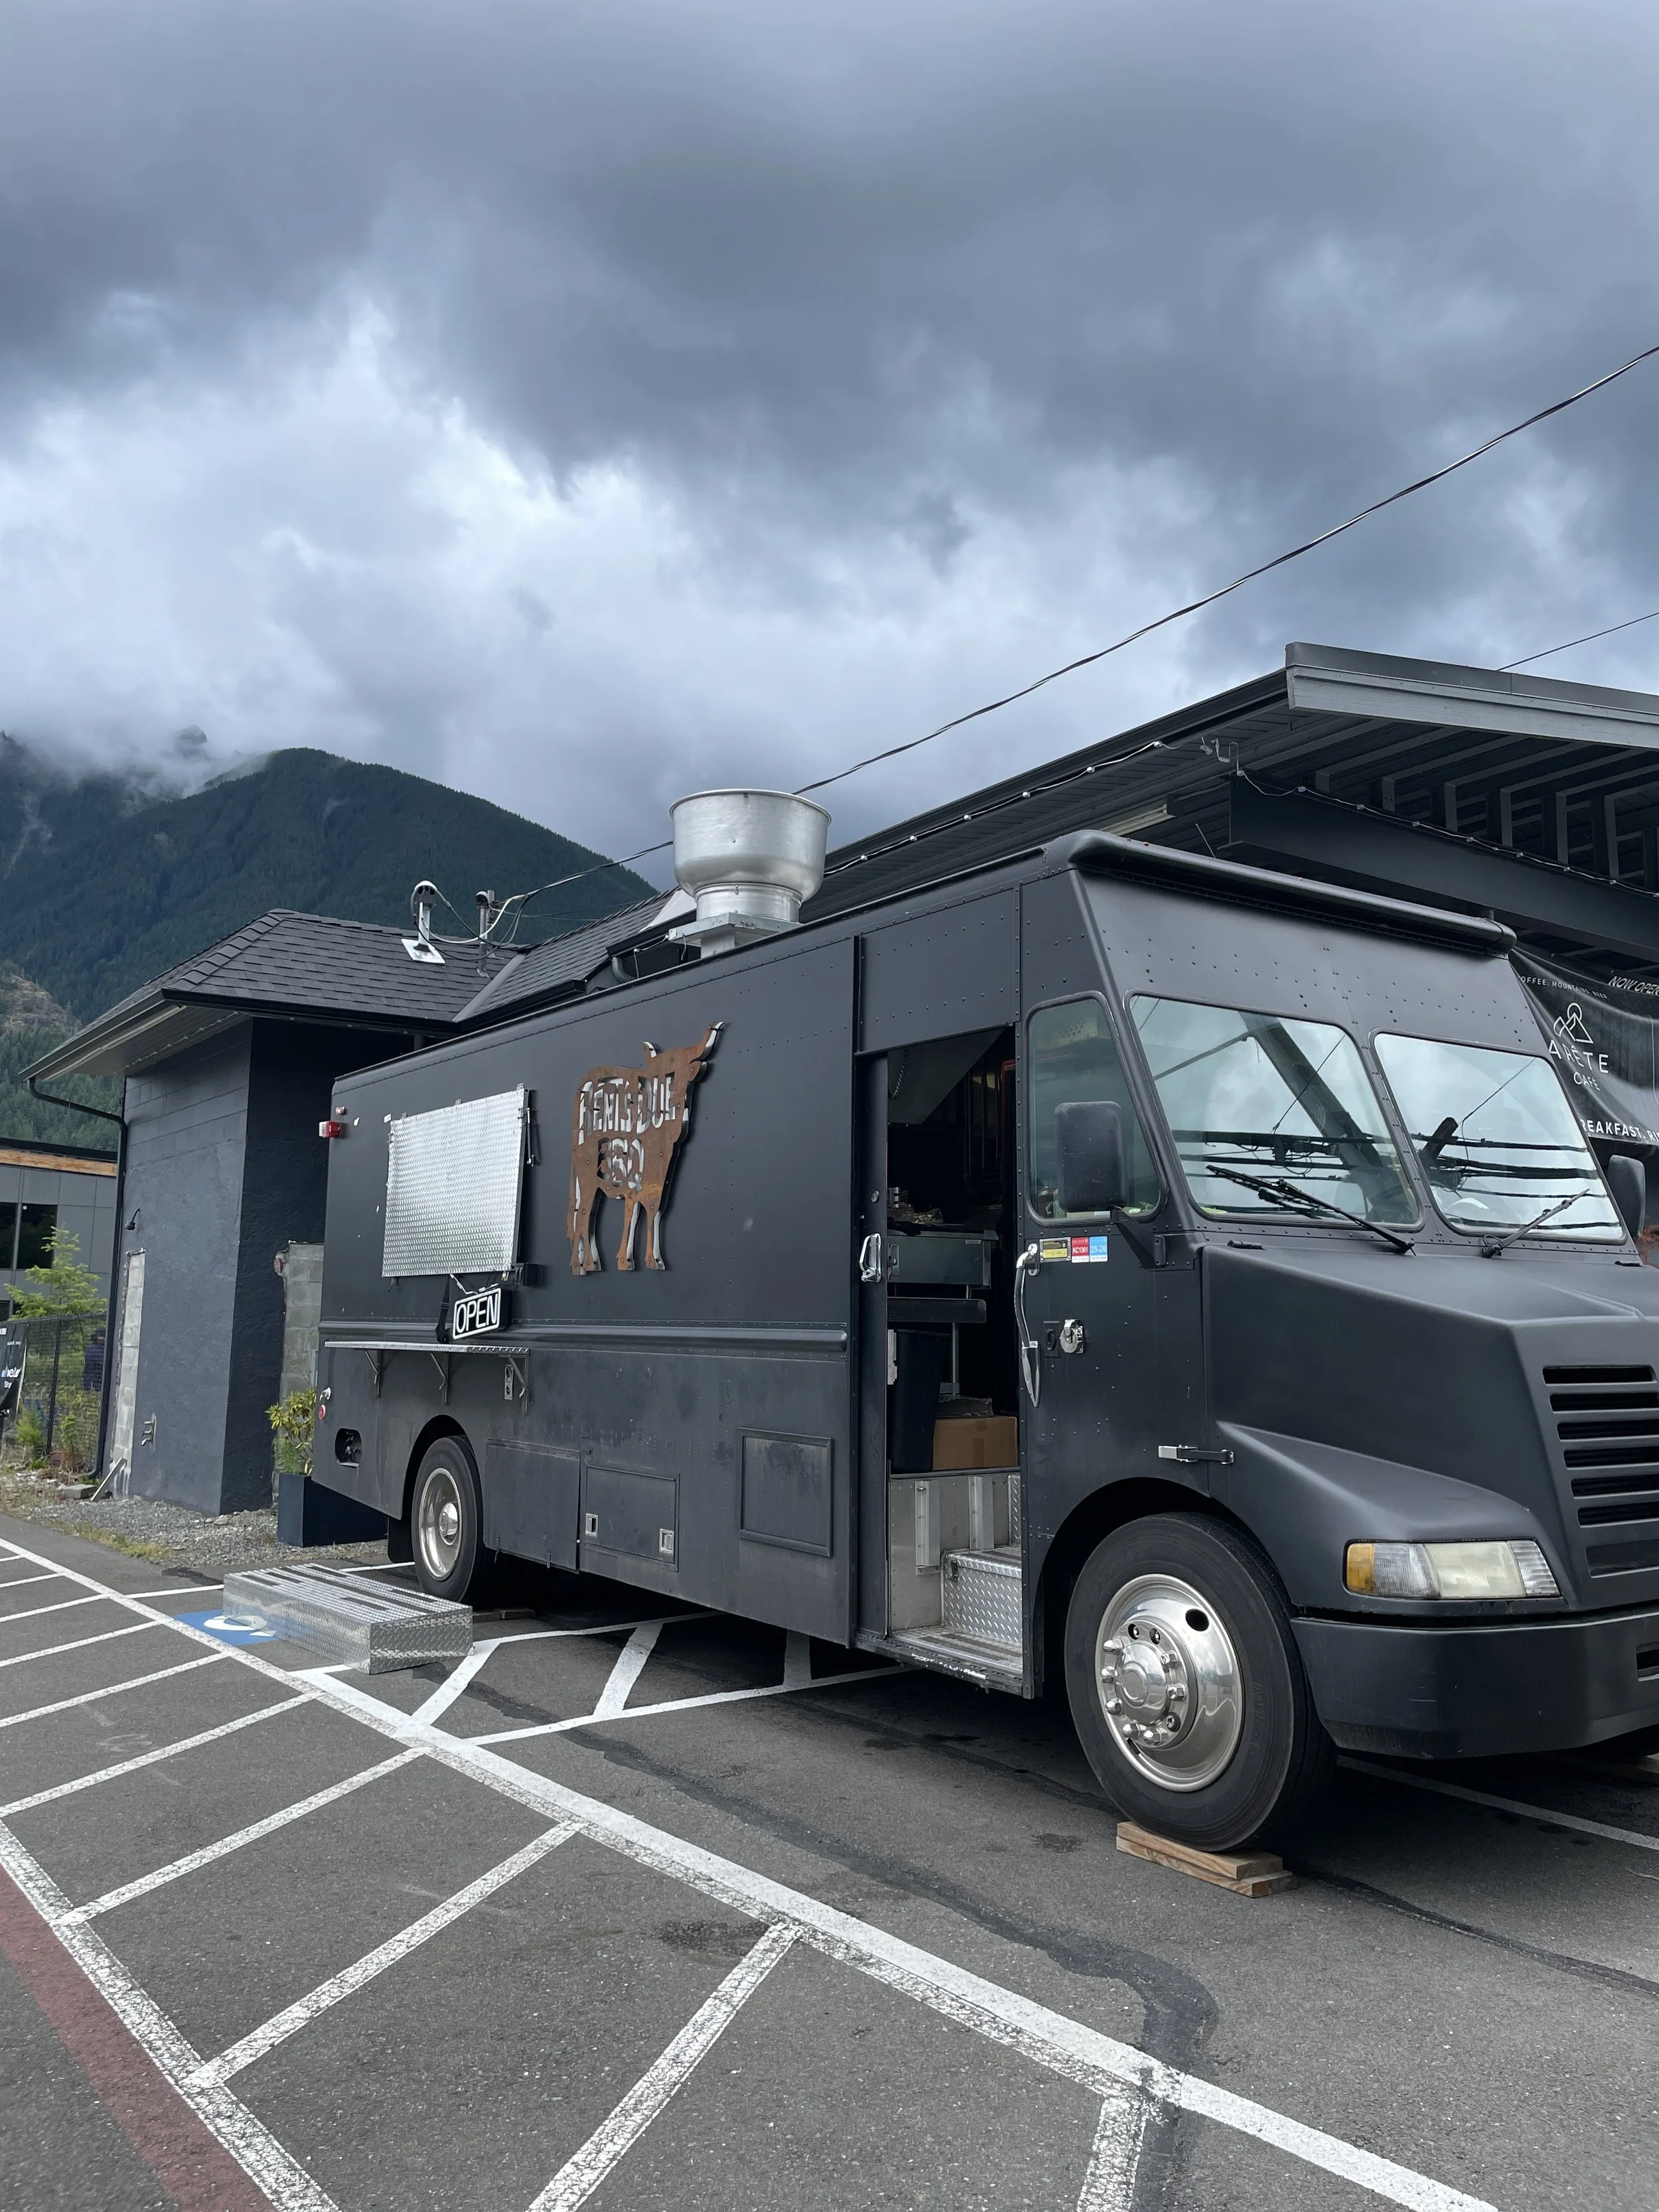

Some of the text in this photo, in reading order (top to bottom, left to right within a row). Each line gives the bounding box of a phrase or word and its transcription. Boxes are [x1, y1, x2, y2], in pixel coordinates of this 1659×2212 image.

[1520, 976, 1549, 986] OFFEE.
[1609, 976, 1638, 990] NOW
[1549, 1039, 1609, 1073] ARÊTE
[636, 1071, 676, 1135] DUE
[1579, 1119, 1659, 1142] REAKFAST. RI
[597, 1137, 644, 1192] BBQ
[456, 1293, 498, 1333] OPEN
